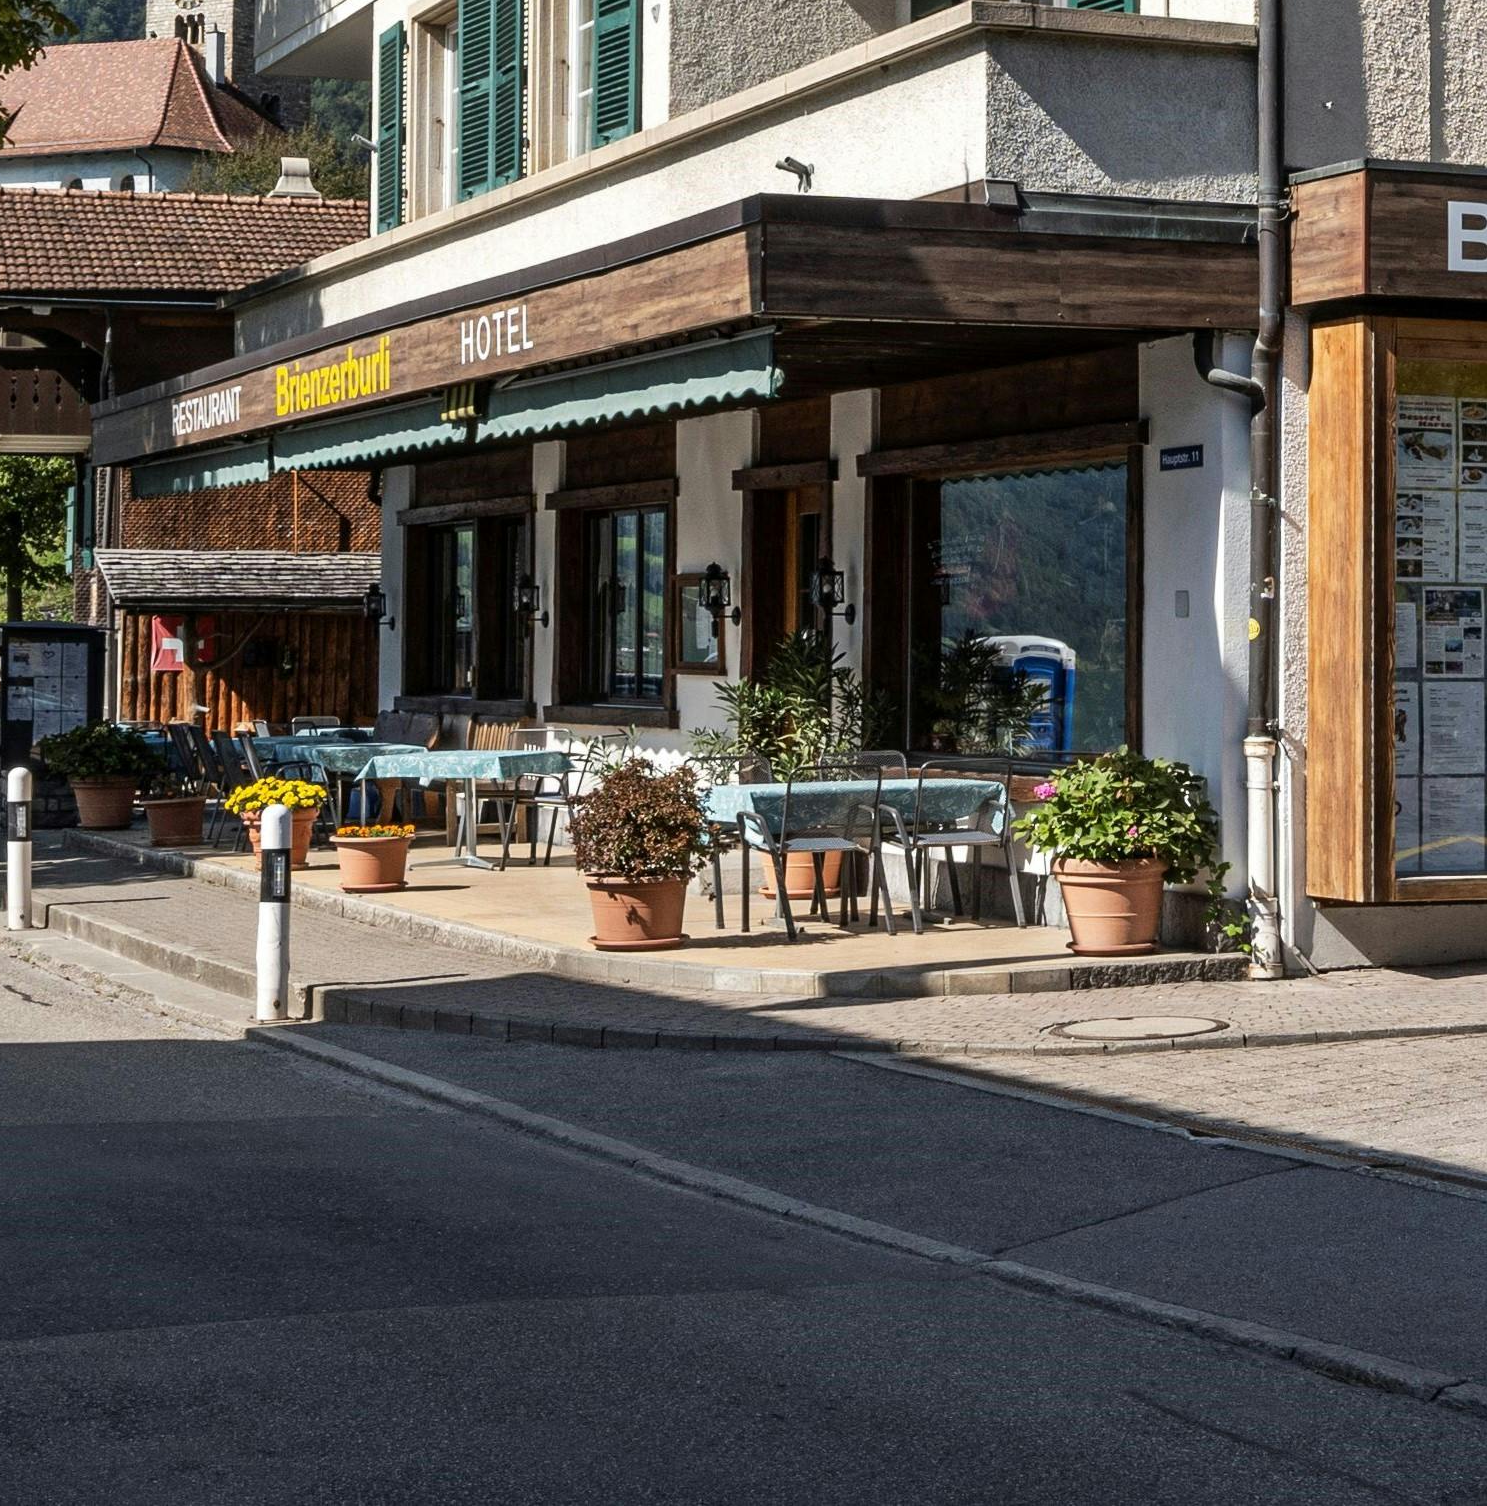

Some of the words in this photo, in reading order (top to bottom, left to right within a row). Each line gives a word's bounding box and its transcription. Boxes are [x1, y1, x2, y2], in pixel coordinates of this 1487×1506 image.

[460, 304, 534, 366] HOTEL
[275, 336, 391, 416] Brienzerburli
[172, 385, 242, 436] RESTAURANT
[1162, 452, 1191, 467] Hauptstr.
[1191, 450, 1200, 462] 11
